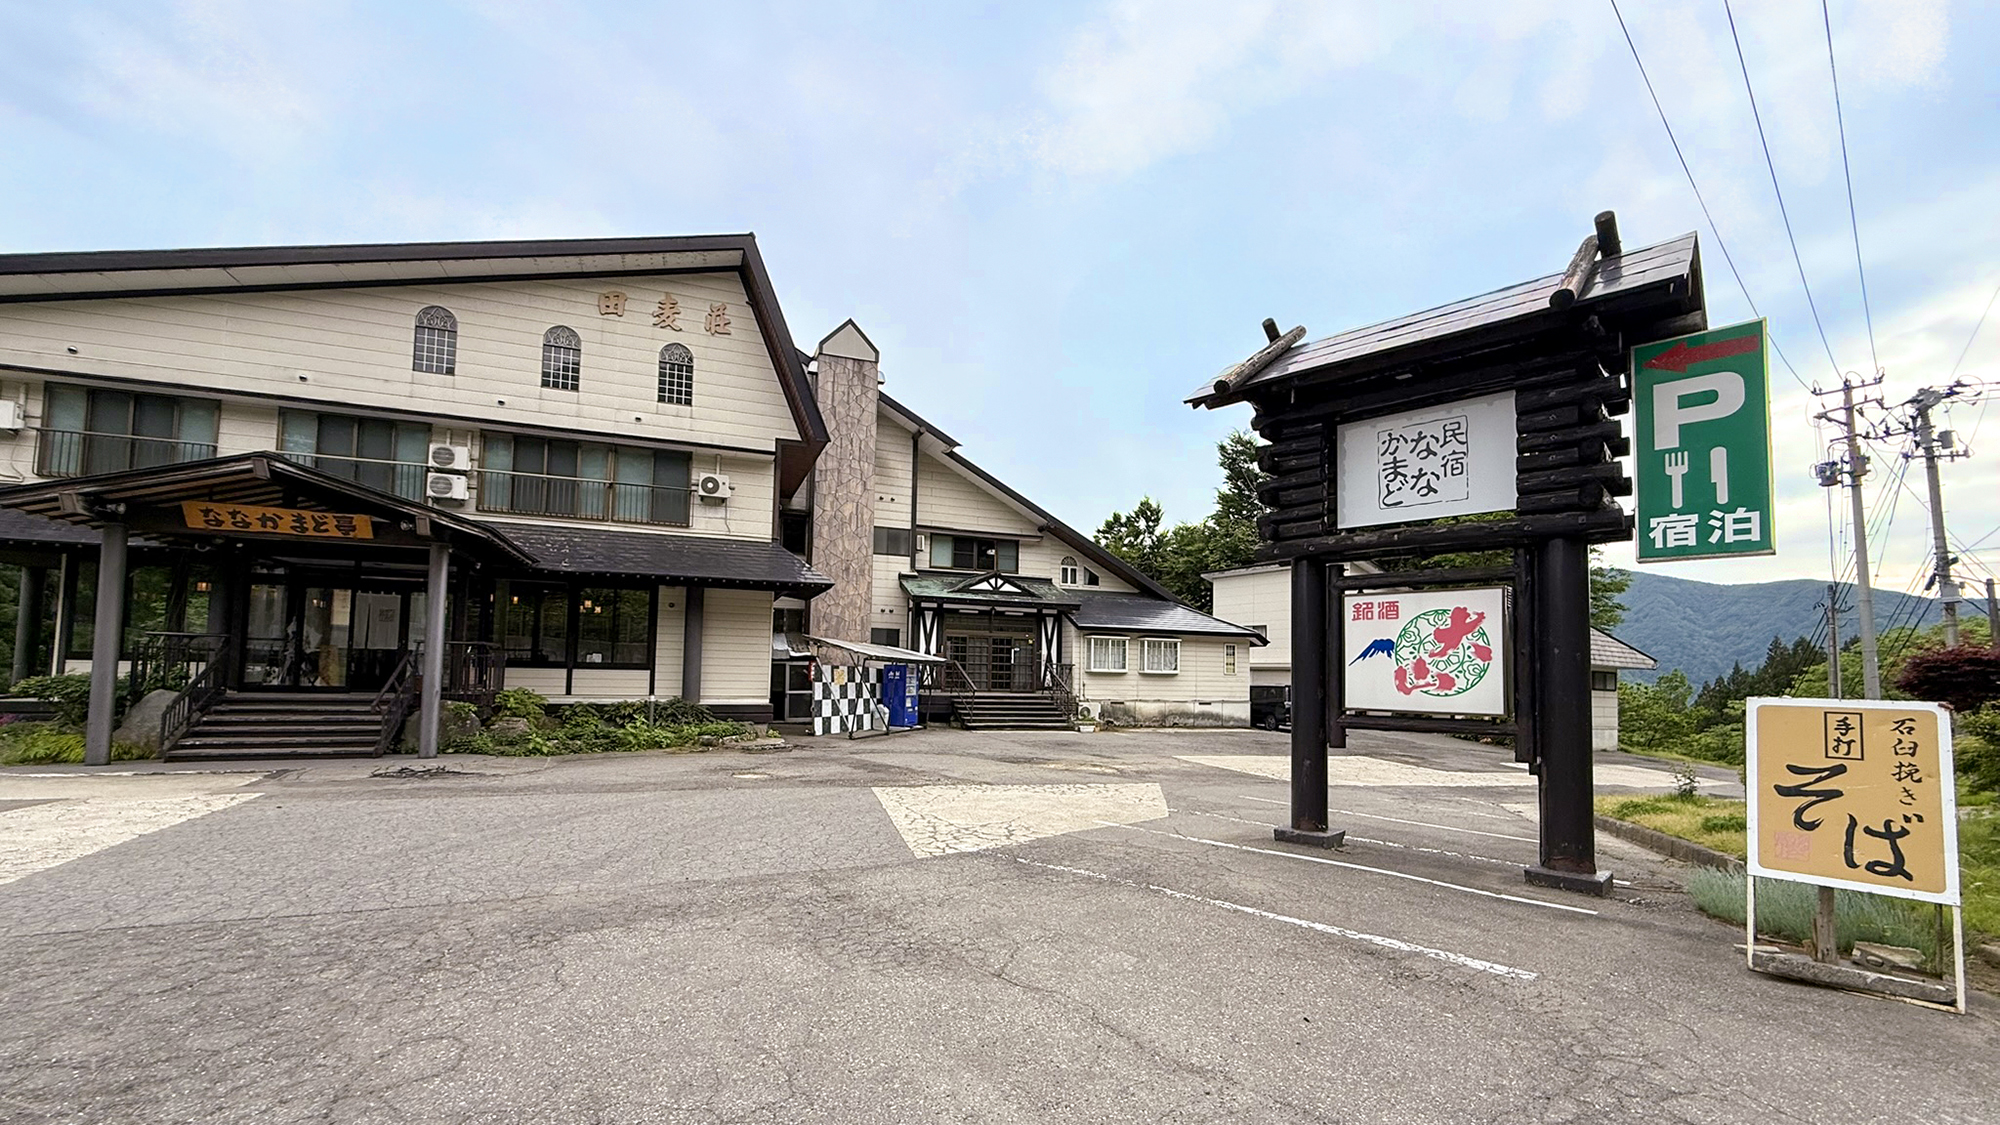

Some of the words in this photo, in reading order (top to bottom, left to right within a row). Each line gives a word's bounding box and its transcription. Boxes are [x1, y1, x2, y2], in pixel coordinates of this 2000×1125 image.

[598, 291, 731, 335] 田麦荘
[1653, 371, 1745, 450] P
[1381, 432, 1409, 507] かまど
[1409, 431, 1440, 497] なな
[1440, 421, 1467, 478] 民宿
[198, 506, 358, 536] ななかまど亭
[1649, 507, 1760, 548] 宿泊
[1352, 601, 1400, 621] 銘酒
[1832, 716, 1856, 756] 手打
[1890, 717, 1923, 806] 石臼挽き
[1773, 763, 1925, 882] そば
